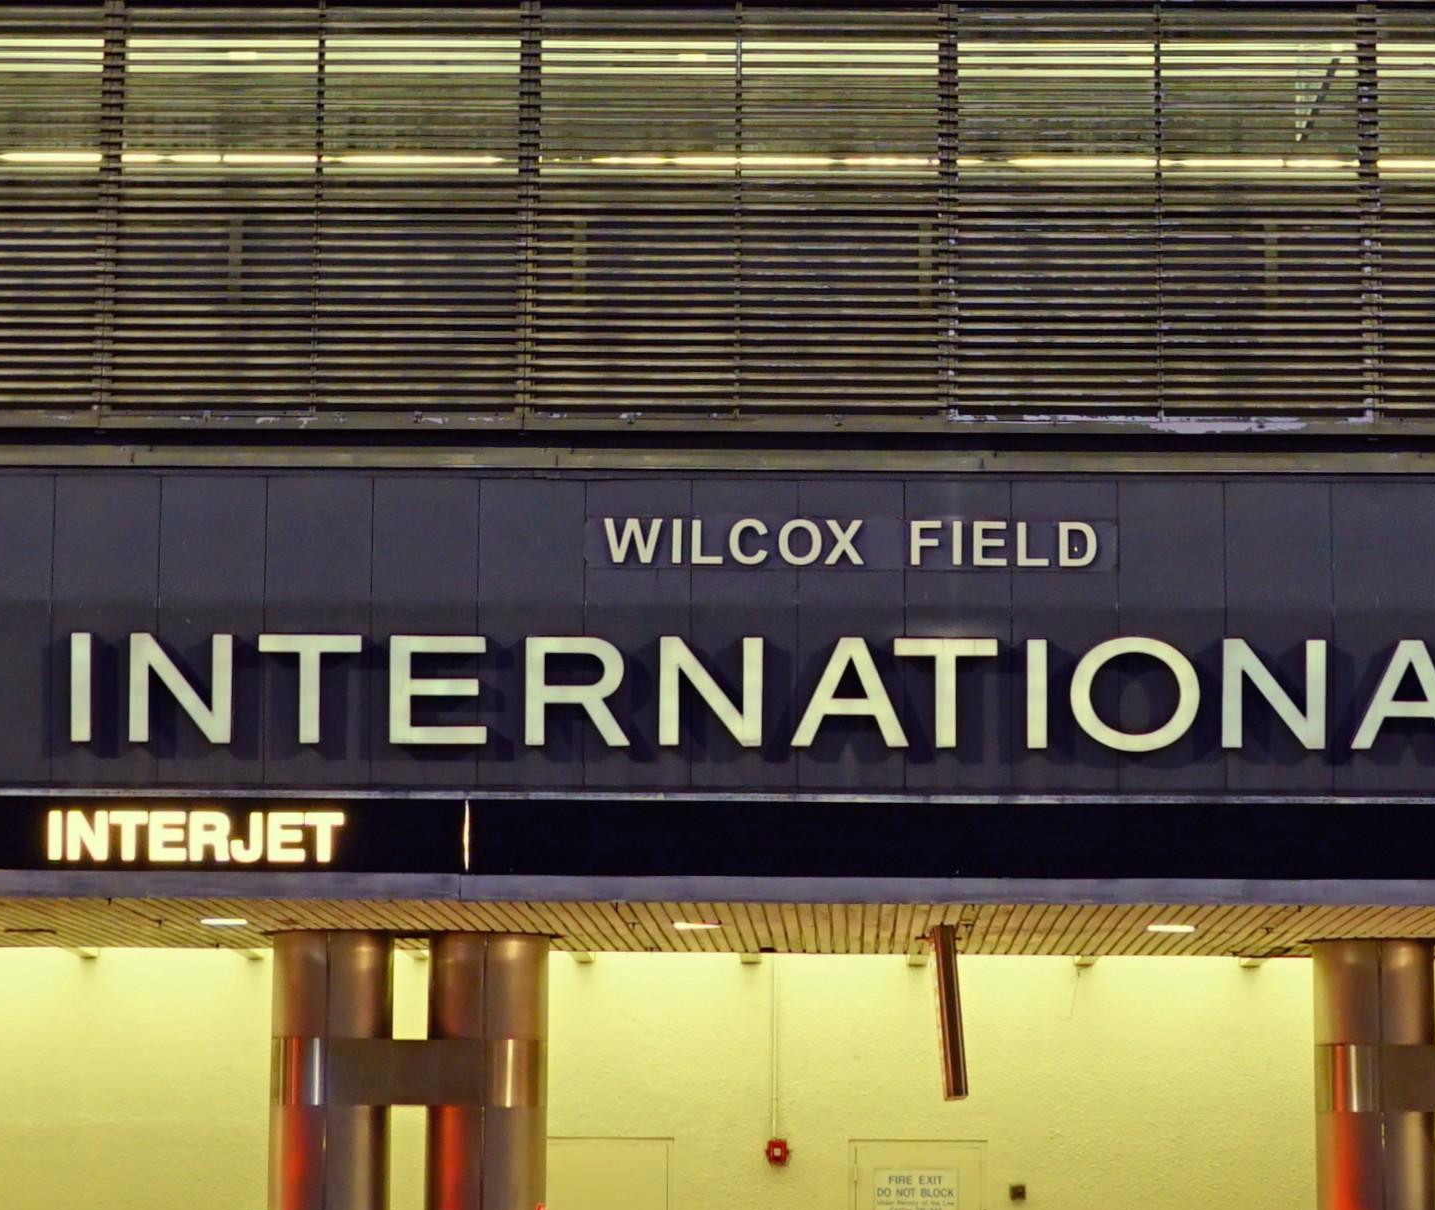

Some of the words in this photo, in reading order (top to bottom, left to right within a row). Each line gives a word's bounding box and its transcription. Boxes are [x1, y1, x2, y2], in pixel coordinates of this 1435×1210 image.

[603, 517, 864, 566] WILCOX
[909, 519, 1099, 568] FIELD
[47, 810, 345, 864] INTERJET
[877, 1187, 892, 1198] DO
[896, 1187, 916, 1198] NOT
[920, 1187, 955, 1198] BLOCK
[888, 1175, 913, 1185] FIRE
[918, 1175, 942, 1185] EXIT
